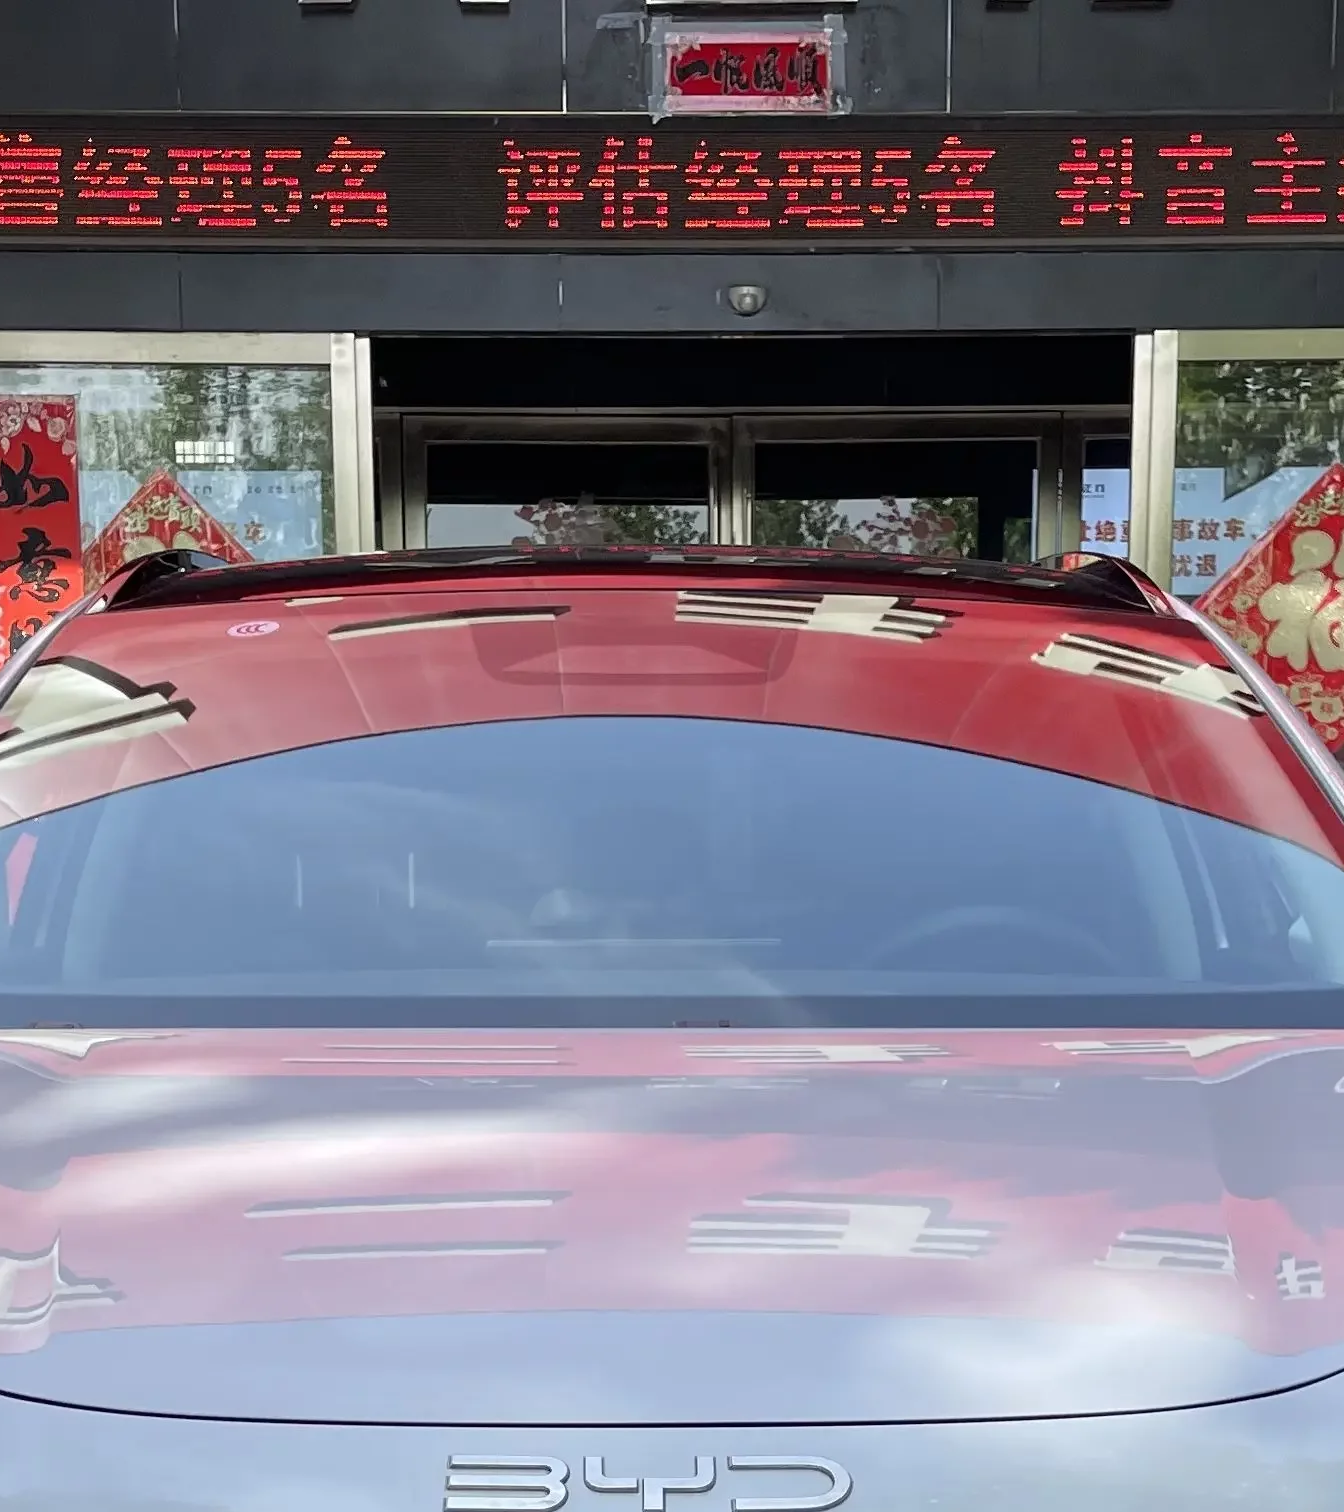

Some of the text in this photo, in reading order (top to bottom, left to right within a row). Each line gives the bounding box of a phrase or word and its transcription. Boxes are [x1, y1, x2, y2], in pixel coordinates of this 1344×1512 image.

[497, 135, 996, 229] 评估经理5名
